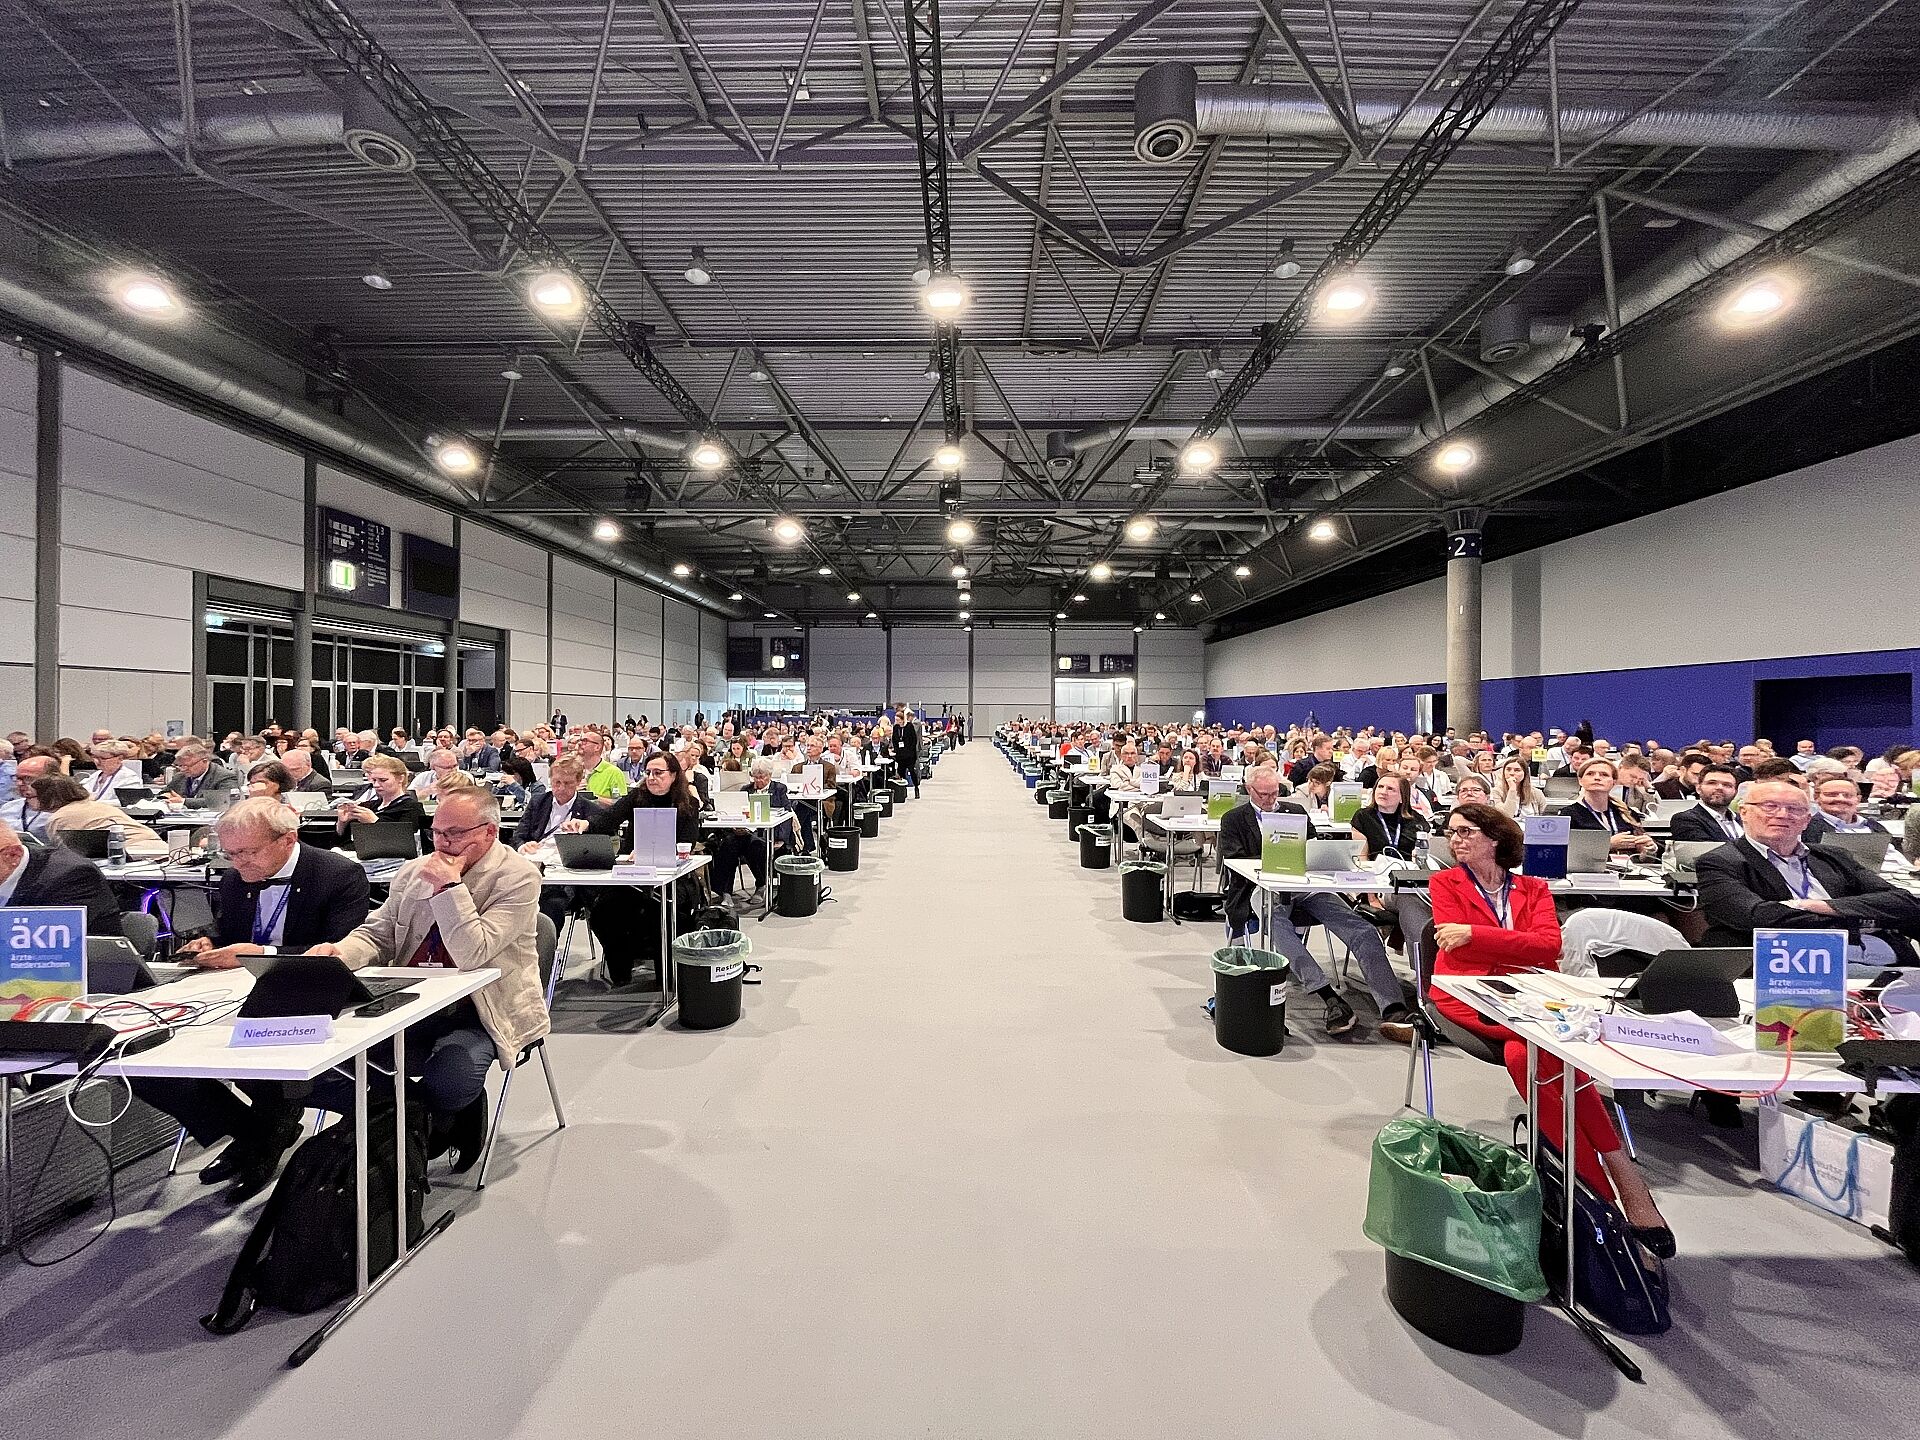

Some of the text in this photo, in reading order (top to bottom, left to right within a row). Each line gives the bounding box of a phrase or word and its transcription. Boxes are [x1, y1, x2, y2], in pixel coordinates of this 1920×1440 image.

[1454, 536, 1466, 557] 2
[10, 917, 70, 949] äkn
[1769, 940, 1831, 974] äkn
[243, 1026, 316, 1038] Niedersachsen
[1617, 1025, 1700, 1046] Niedersachsen
